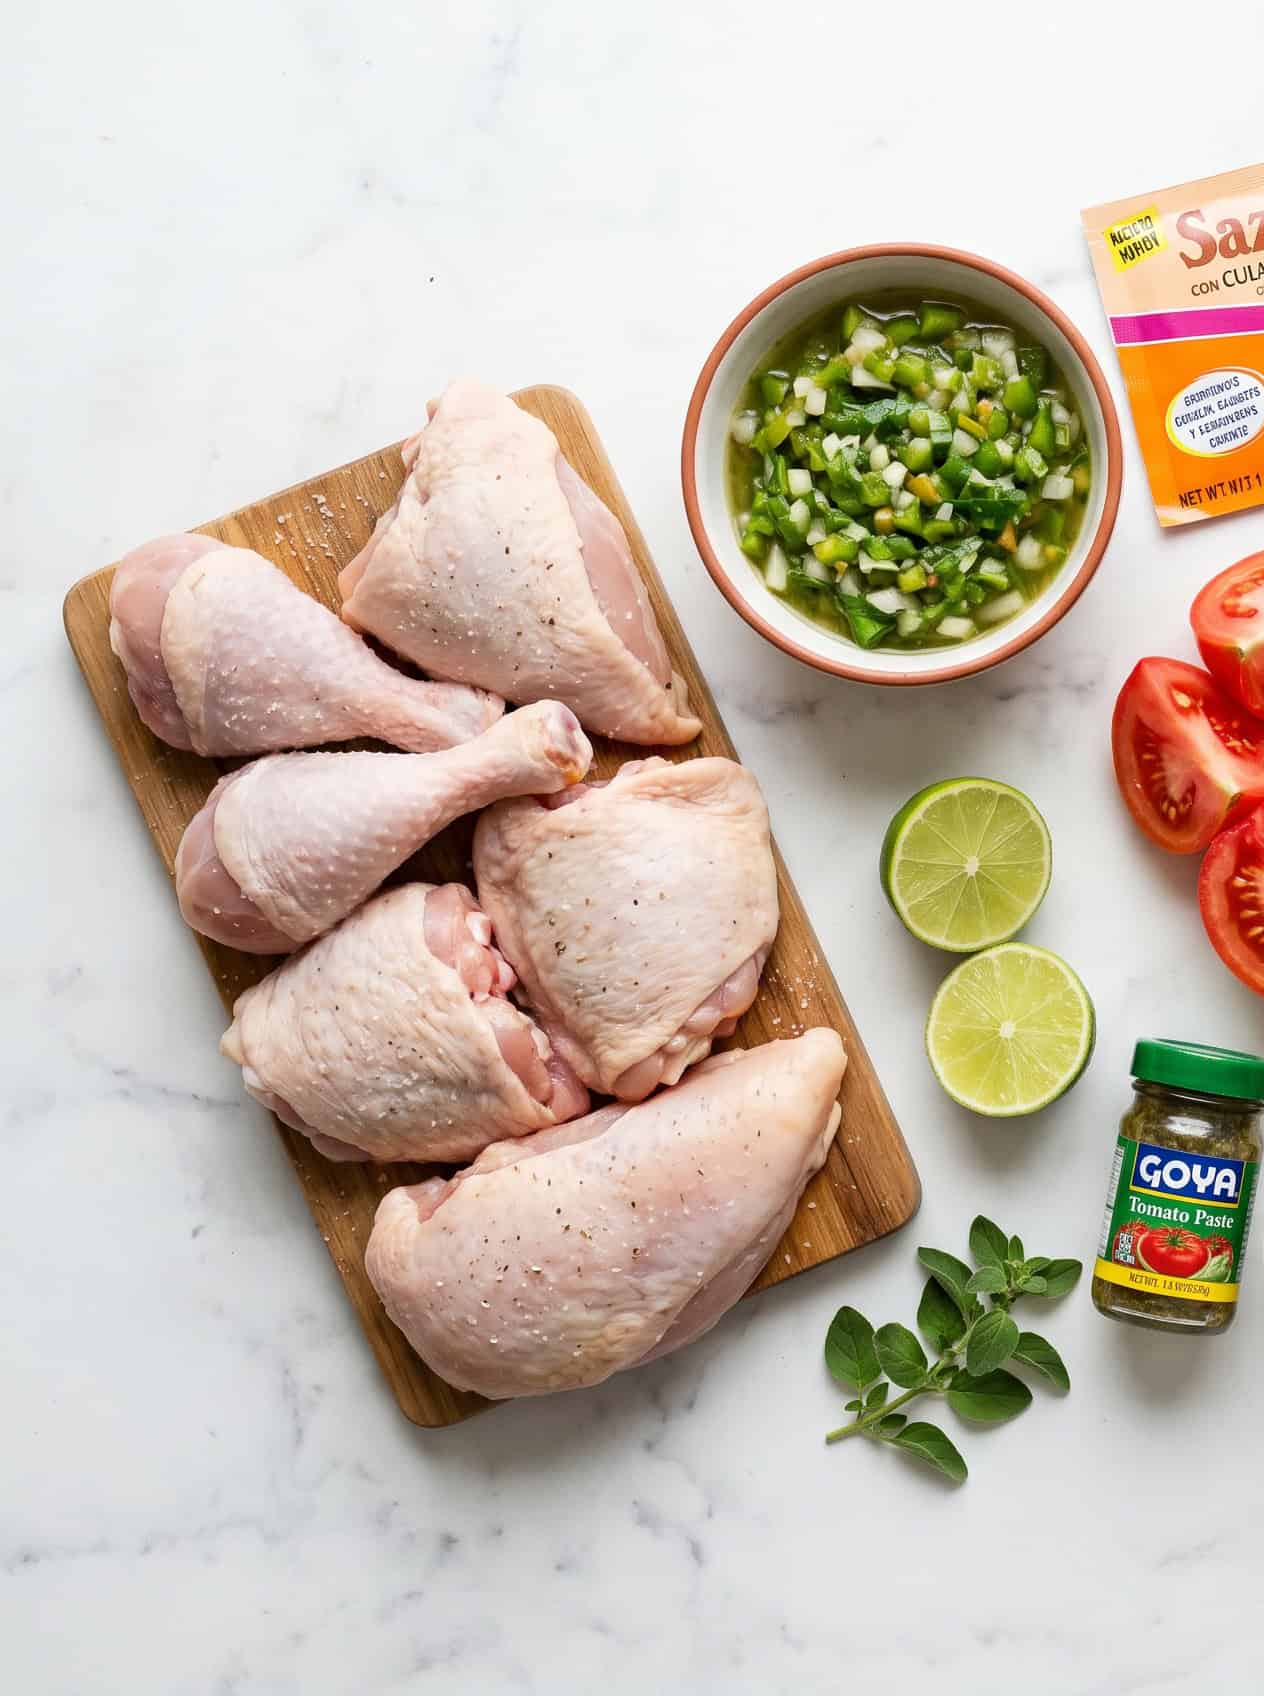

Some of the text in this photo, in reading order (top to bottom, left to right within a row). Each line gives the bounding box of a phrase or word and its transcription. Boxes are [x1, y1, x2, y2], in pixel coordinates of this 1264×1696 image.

[1191, 278, 1220, 297] CON
[1178, 489, 1203, 509] NET
[1206, 481, 1227, 501] WT
[1139, 1154, 1238, 1198] GOYA
[1128, 1195, 1234, 1230] Tomato Paste
